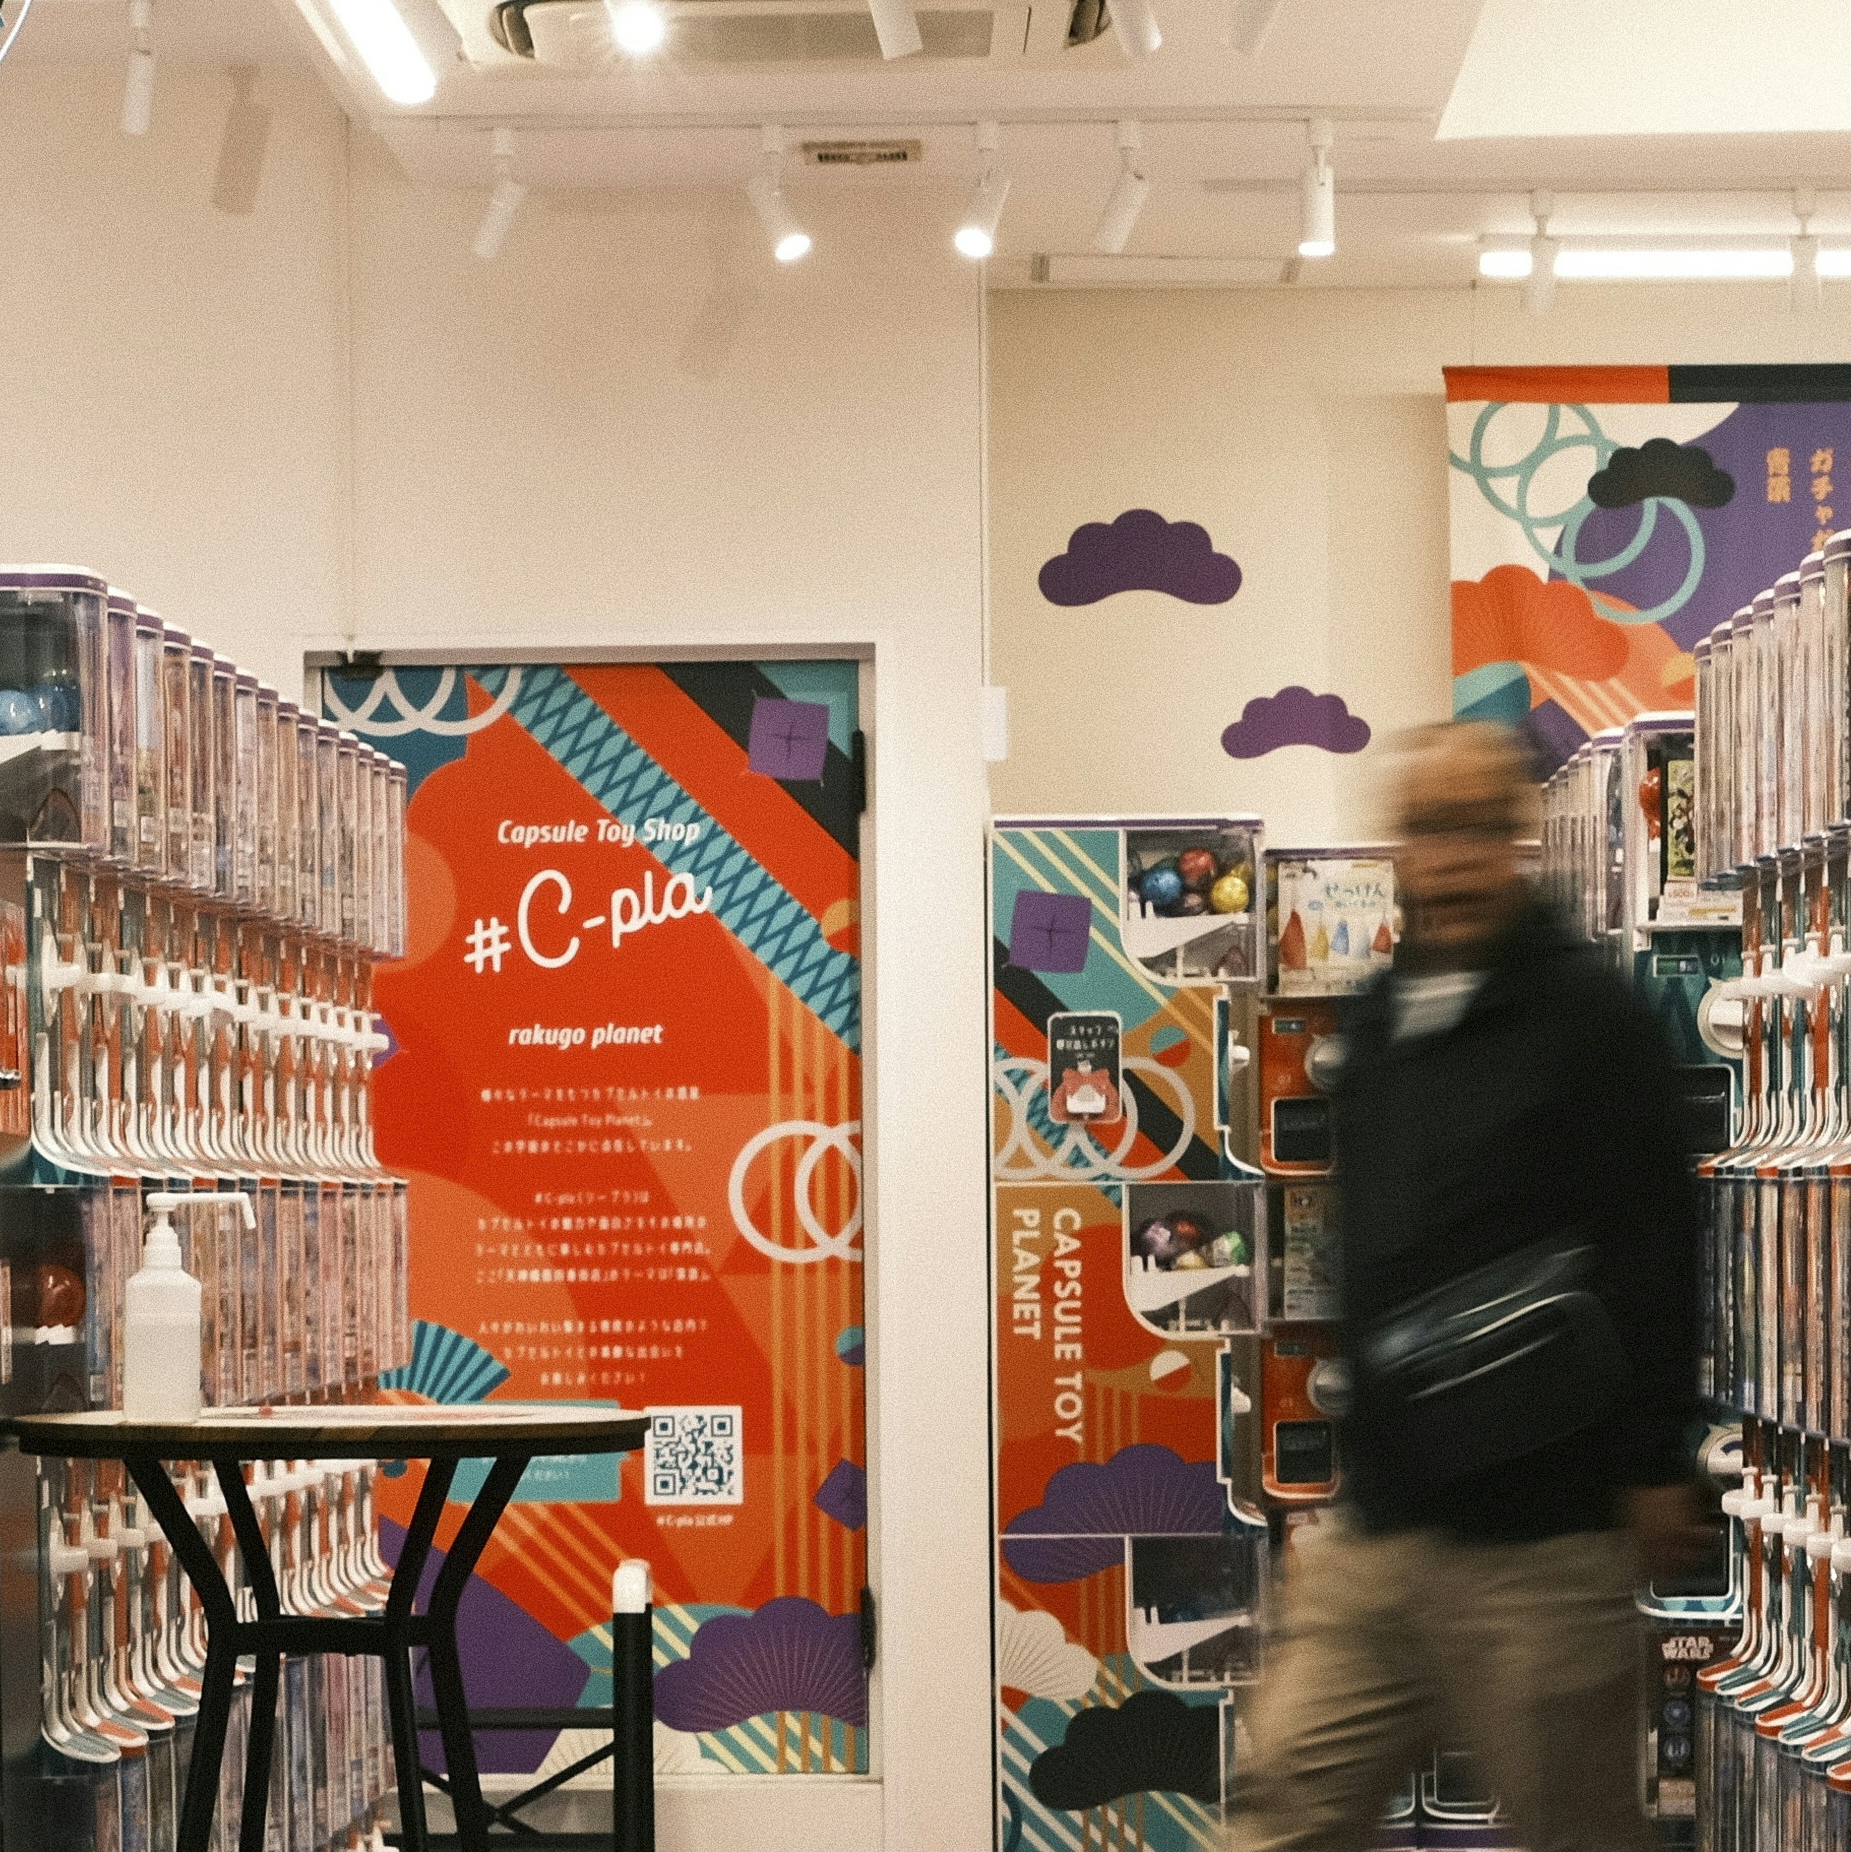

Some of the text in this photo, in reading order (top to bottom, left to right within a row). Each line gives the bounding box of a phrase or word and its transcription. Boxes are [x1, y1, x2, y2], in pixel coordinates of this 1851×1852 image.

[497, 818, 701, 847] Capsule Toy Shop
[463, 868, 714, 975] #C-pla
[508, 1021, 664, 1051] rakugo planet
[1011, 1208, 1042, 1341] PLANET
[1052, 1207, 1084, 1444] CAPSULE TOY
